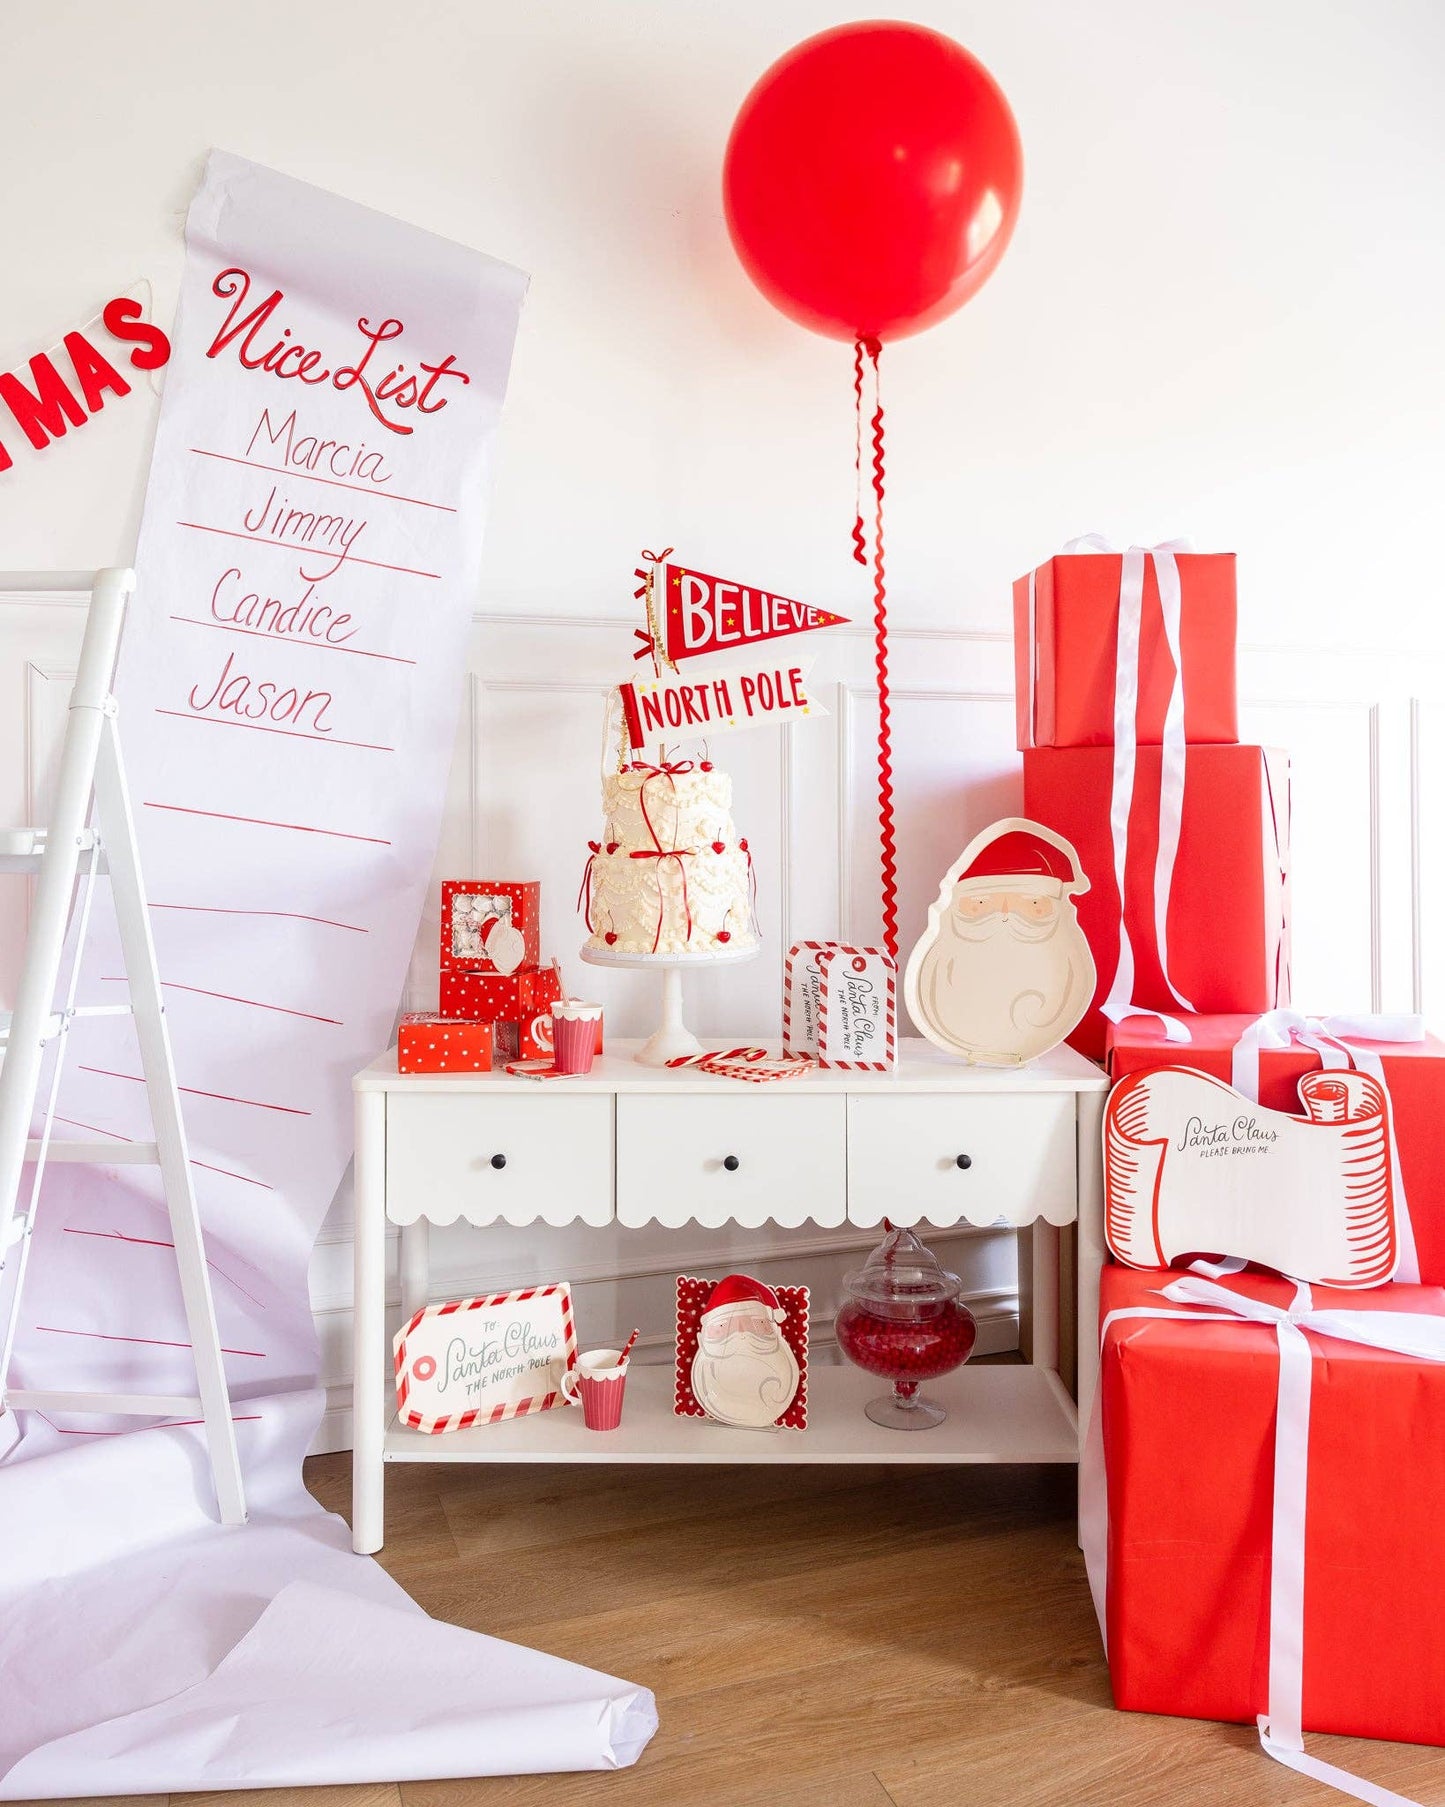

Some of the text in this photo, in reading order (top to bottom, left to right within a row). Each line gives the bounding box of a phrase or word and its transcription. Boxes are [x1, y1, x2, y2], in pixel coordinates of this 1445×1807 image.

[0, 297, 171, 472] MAS
[206, 268, 470, 435] Nice List
[246, 408, 392, 483] Marcia
[244, 487, 367, 581] Jimmy
[211, 568, 361, 643] Candice
[681, 574, 820, 649] BELIEVE
[188, 652, 333, 732] Jason
[641, 668, 807, 731] NORTH POLE
[801, 983, 809, 997] THE
[838, 989, 846, 1003] THE
[841, 1006, 849, 1030] NORTH
[842, 970, 875, 1057] Santa Claus
[1177, 1115, 1280, 1152] Santa Claus
[1200, 1146, 1229, 1158] PLEASE
[1231, 1145, 1256, 1155] BRING
[437, 1321, 560, 1393] Santa Claus
[465, 1354, 552, 1395] THE NORTH POLE
